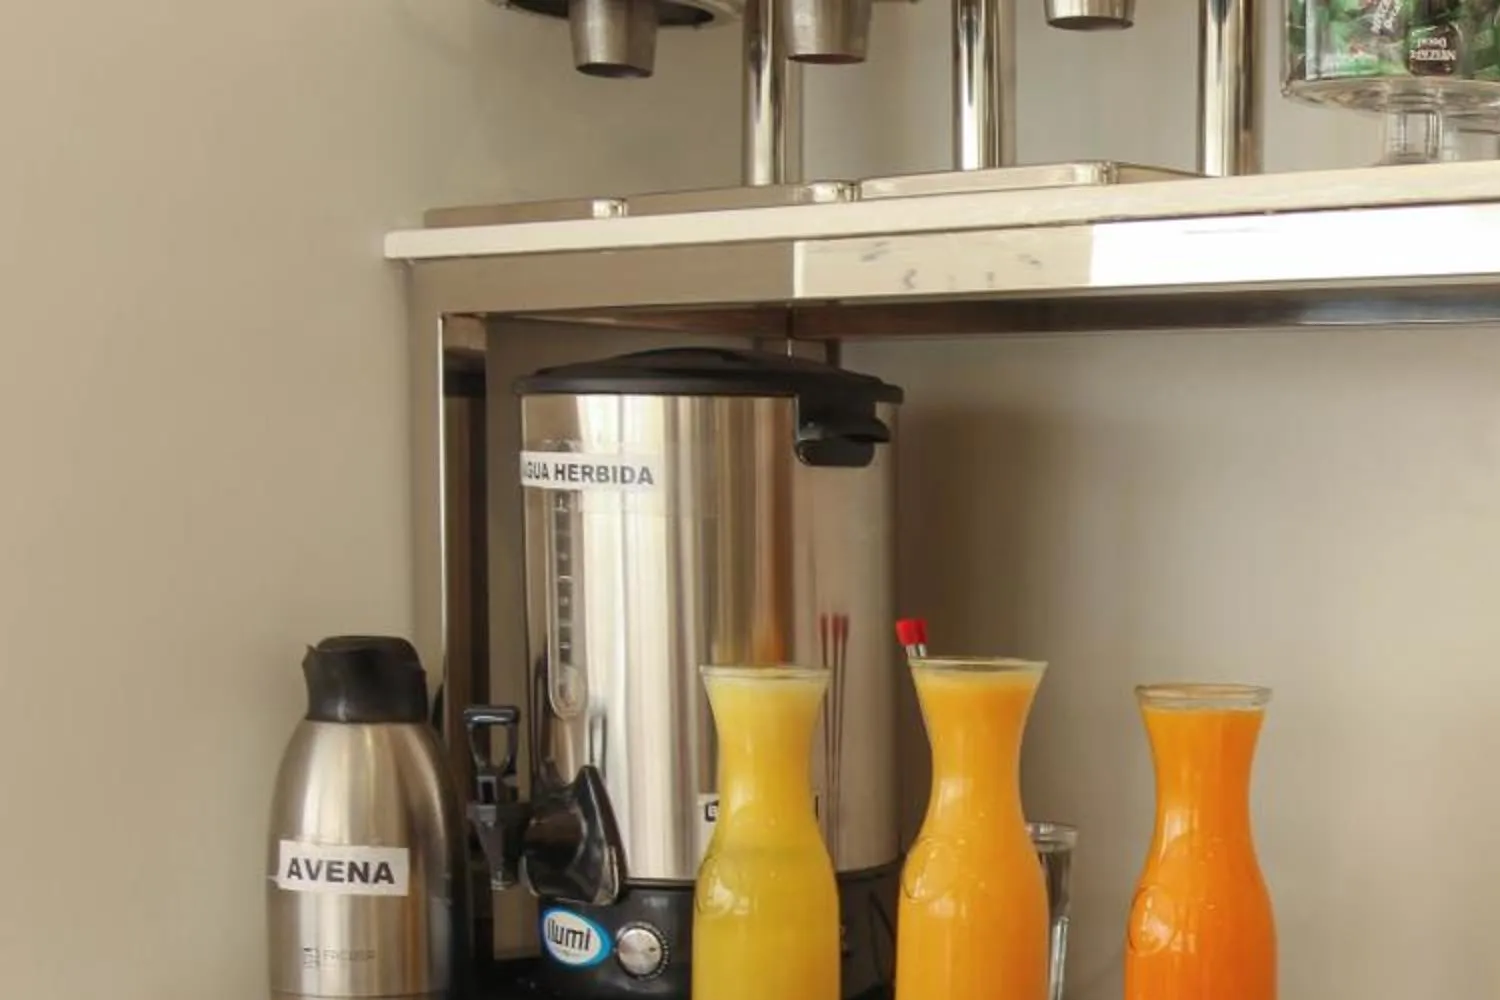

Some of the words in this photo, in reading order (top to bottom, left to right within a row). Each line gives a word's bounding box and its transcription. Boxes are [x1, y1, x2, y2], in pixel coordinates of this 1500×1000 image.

[524, 461, 550, 480] GUA
[554, 463, 654, 485] HERBIDA
[287, 857, 396, 885] AVENA
